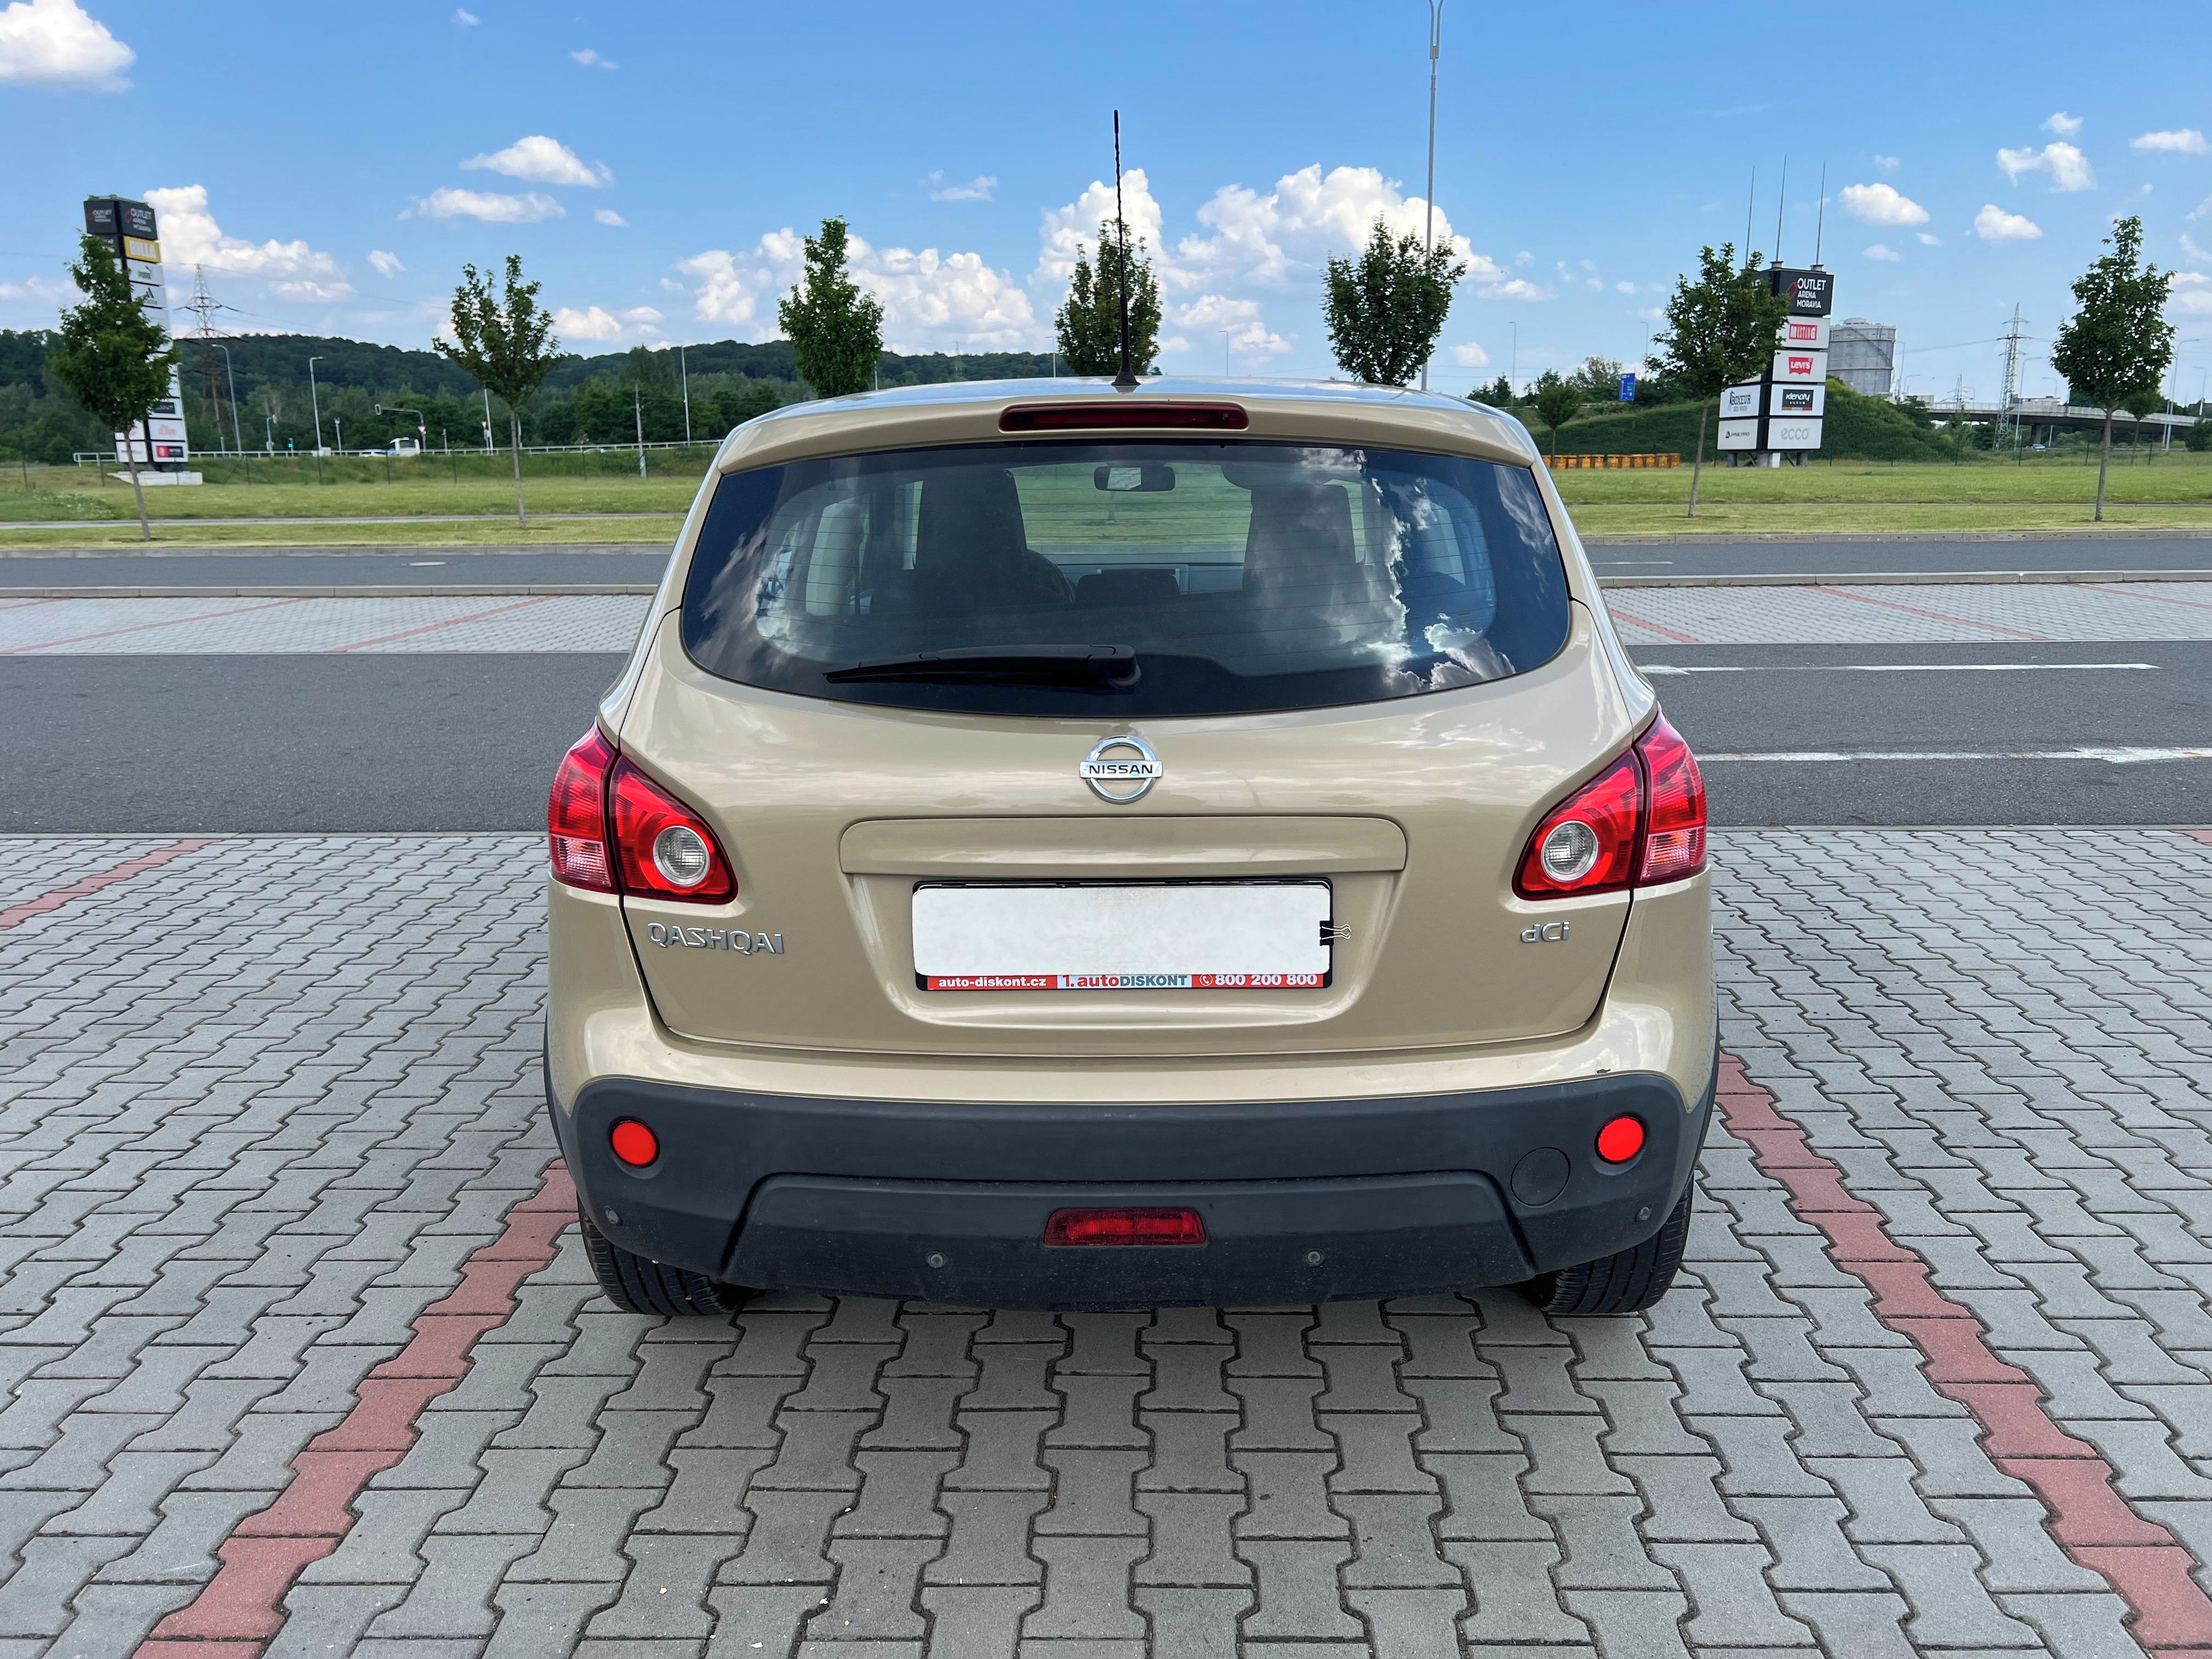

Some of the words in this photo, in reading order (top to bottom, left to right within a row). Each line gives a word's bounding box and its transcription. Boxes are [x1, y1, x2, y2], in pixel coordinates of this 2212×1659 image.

[129, 240, 156, 258] BILLA
[1797, 278, 1826, 291] OUTLET
[1797, 290, 1816, 299] ARENA
[1796, 300, 1821, 308] MORAVIA
[1781, 428, 1809, 440] ecco
[1089, 765, 1153, 774] NISSAN
[647, 922, 783, 955] QASHQAI
[1521, 922, 1570, 943] dCi
[939, 977, 1047, 988] auto-diskont.cz
[1215, 974, 1246, 986] 800
[1250, 974, 1282, 986] 200
[1286, 974, 1317, 986] 800
